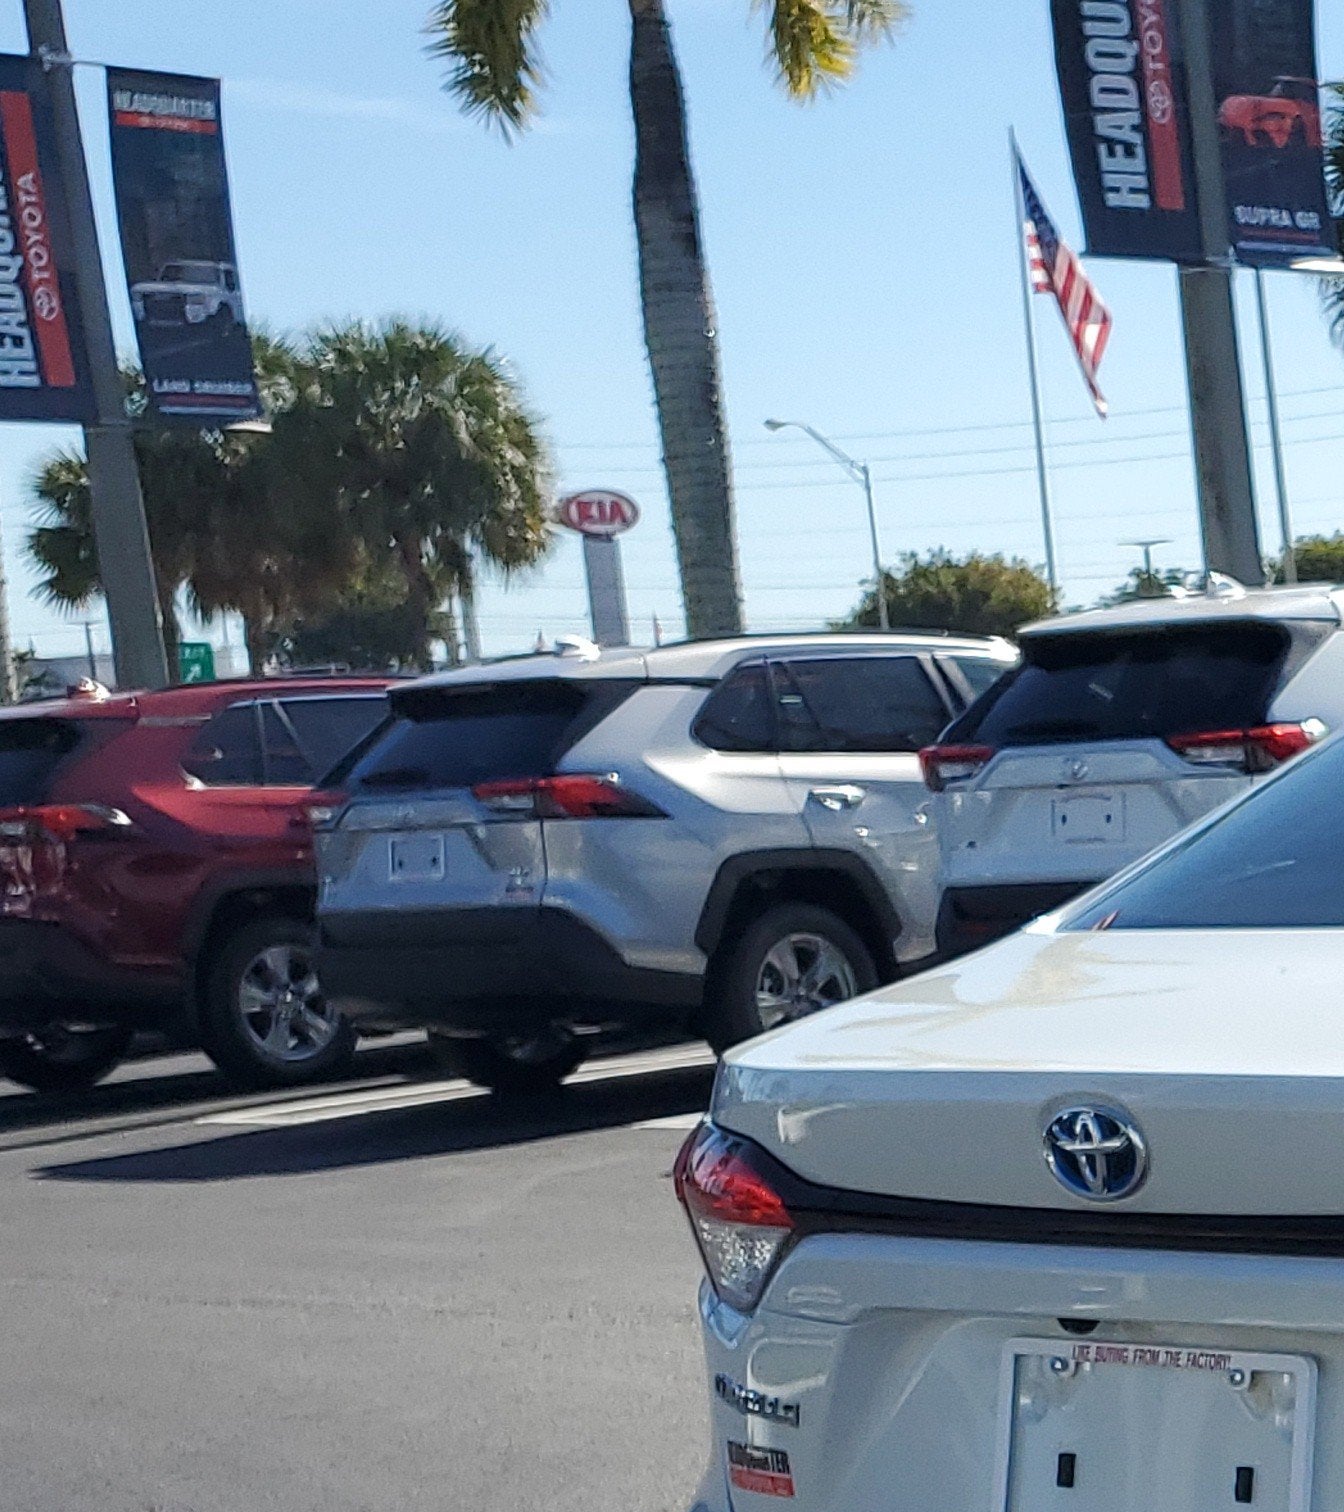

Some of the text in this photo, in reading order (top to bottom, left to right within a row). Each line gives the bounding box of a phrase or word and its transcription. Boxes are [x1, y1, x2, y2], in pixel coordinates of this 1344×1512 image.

[1138, 0, 1166, 78] TOY
[17, 172, 51, 280] TOYOTA
[576, 501, 628, 523] KIA
[1164, 1350, 1182, 1368] THE
